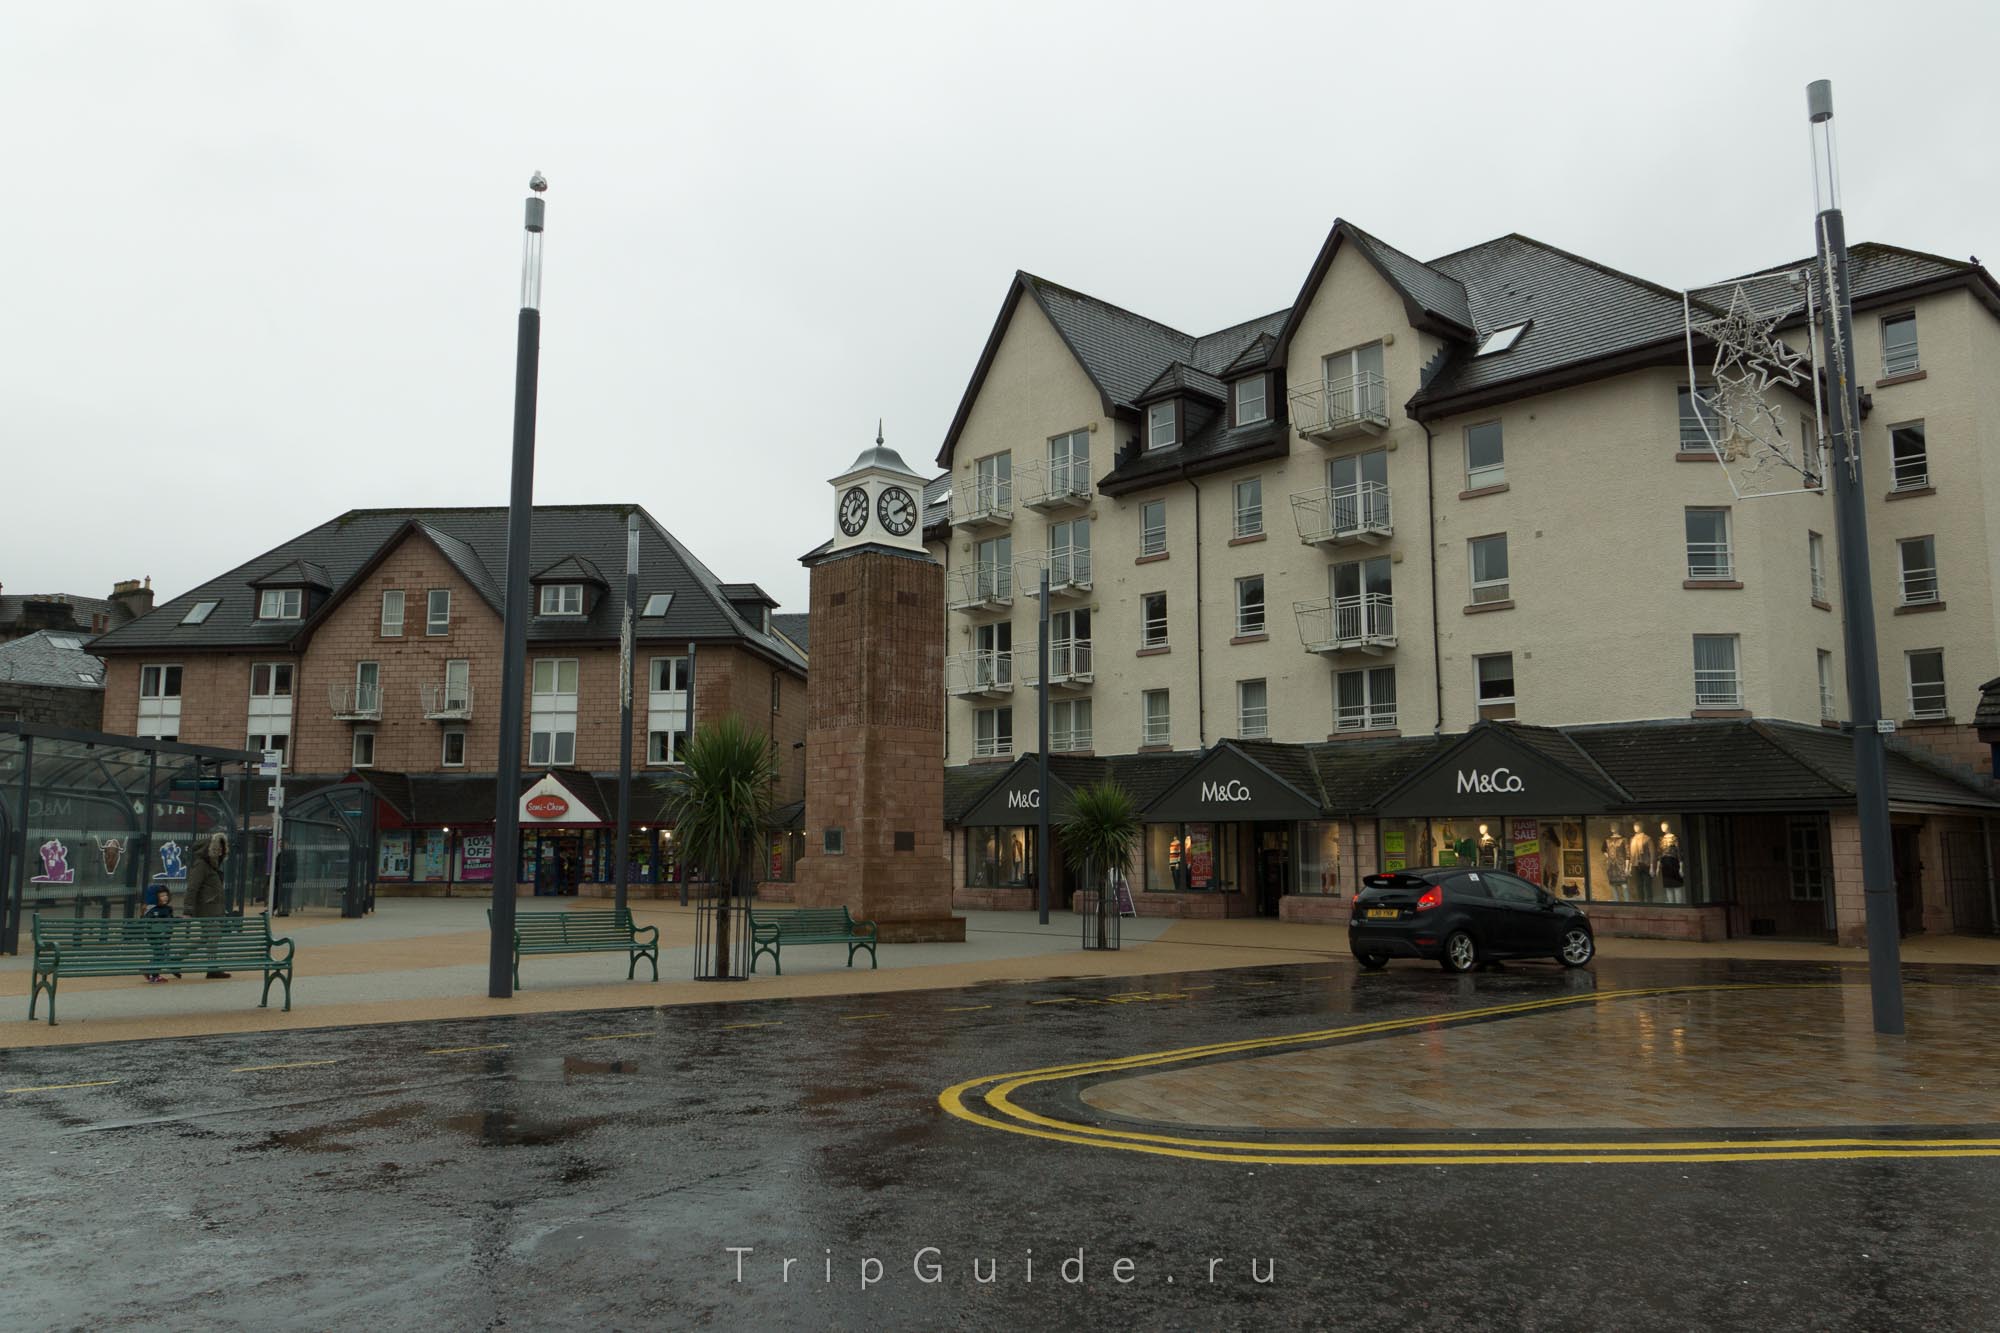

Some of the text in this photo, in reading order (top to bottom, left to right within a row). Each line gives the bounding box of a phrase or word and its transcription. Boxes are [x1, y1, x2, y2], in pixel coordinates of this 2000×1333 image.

[1457, 767, 1525, 794] M&Co.
[1008, 788, 1040, 809] M&C
[1201, 779, 1251, 802] M&Co.
[467, 836, 490, 847] 10%
[1514, 829, 1537, 841] SALE
[467, 847, 490, 857] OFF
